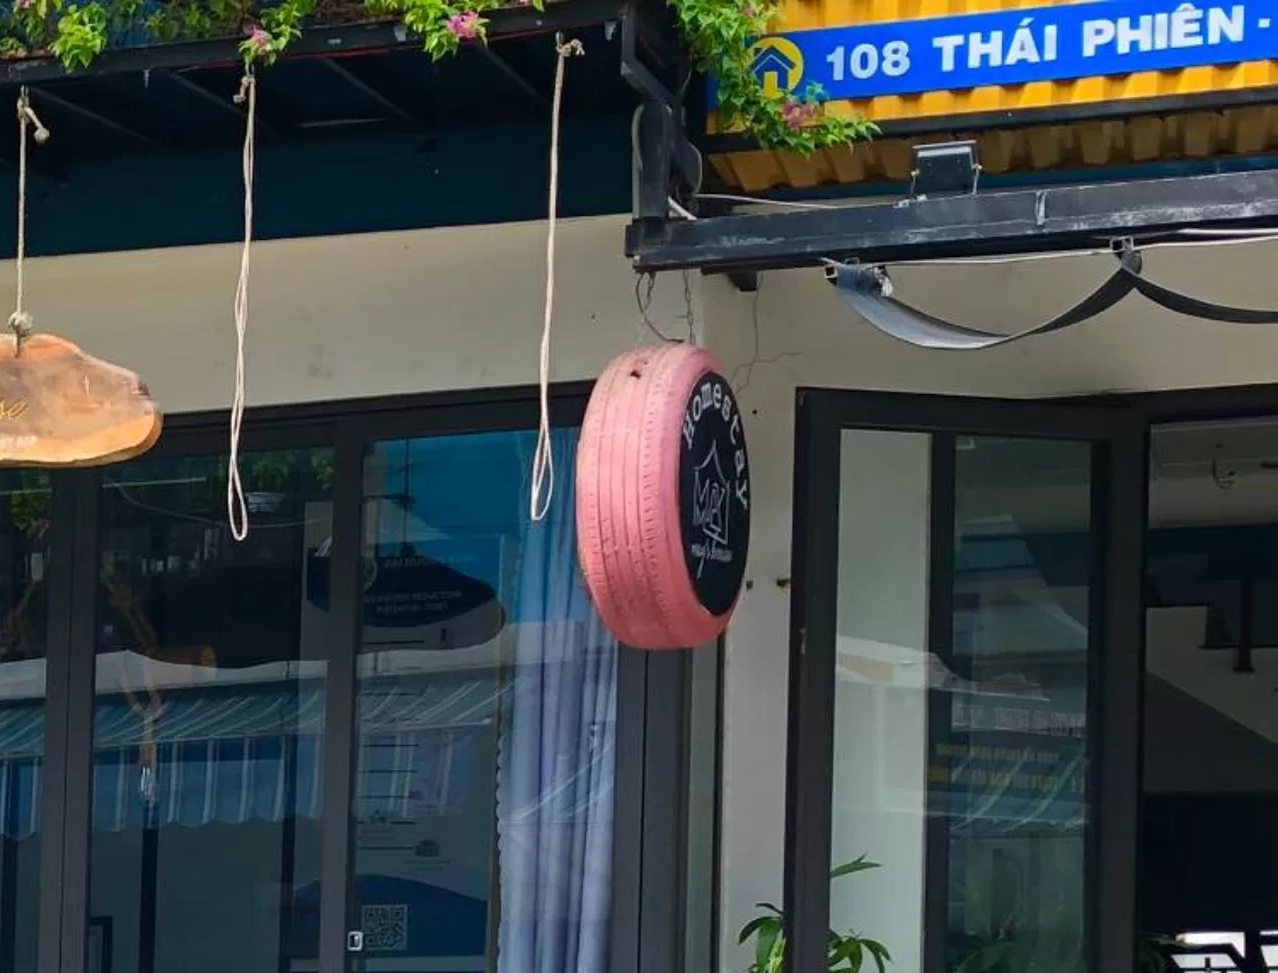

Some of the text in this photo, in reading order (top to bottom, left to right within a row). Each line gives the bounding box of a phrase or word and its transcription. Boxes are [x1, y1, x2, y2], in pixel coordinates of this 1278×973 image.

[826, 41, 910, 81] 108
[933, 18, 1057, 72] THÁI
[1082, 3, 1244, 58] PHIÊN
